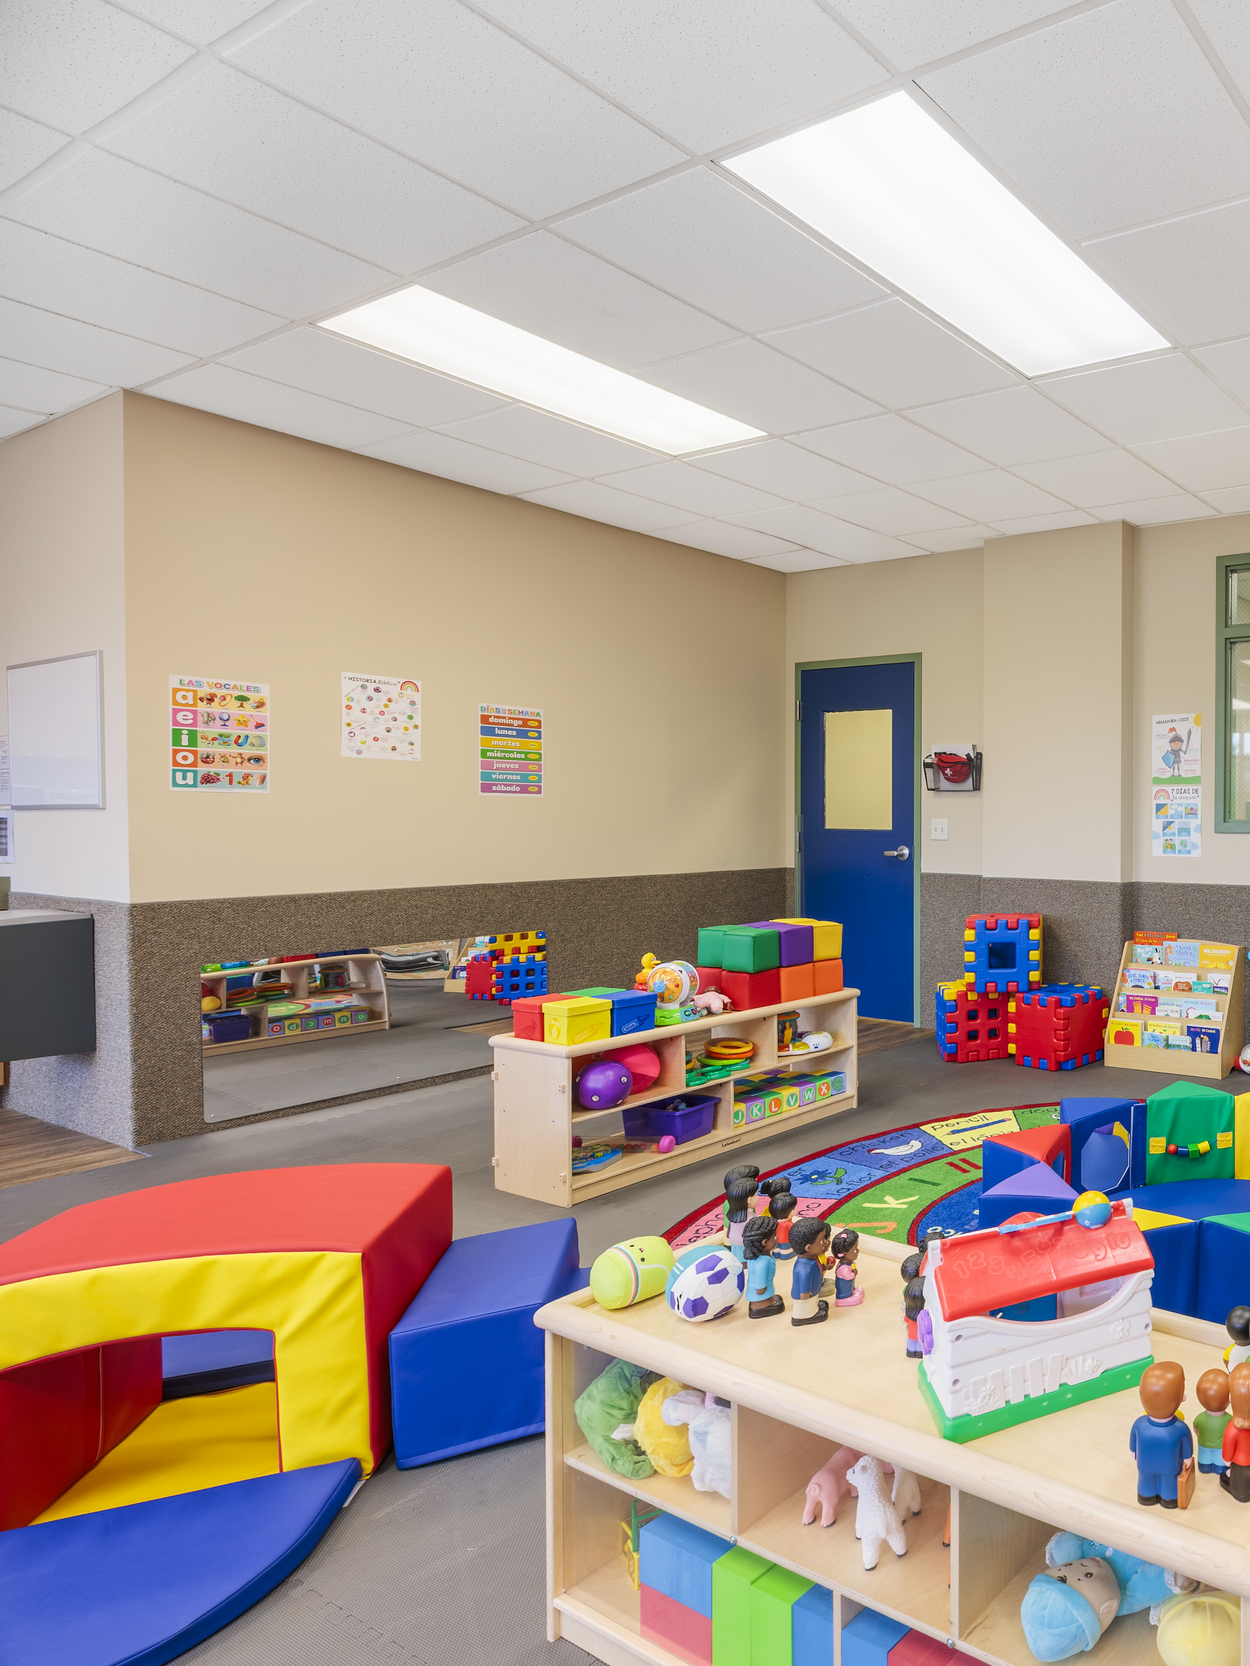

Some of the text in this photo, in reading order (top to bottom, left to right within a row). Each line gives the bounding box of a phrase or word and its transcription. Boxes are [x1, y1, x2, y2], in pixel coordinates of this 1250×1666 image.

[179, 679, 261, 693] LAS VOCALES
[176, 691, 194, 705] a
[176, 711, 194, 724] e
[480, 705, 501, 714] DÍAS
[507, 709, 541, 718] SEMANA
[489, 716, 522, 727] domingo
[181, 730, 189, 746] i
[495, 728, 517, 736] lunes
[176, 751, 194, 765] o
[493, 761, 519, 769] jueves
[175, 771, 194, 785] u
[805, 1090, 814, 1100] W
[821, 1084, 828, 1094] X
[772, 1101, 779, 1111] L
[789, 1096, 796, 1106] V
[734, 1111, 741, 1123] J
[753, 1105, 760, 1116] K
[932, 1115, 989, 1131] pencil
[839, 1132, 913, 1156] chicken
[880, 1146, 944, 1169] el pollo
[846, 1173, 876, 1186] flor
[954, 1261, 970, 1278] 1
[967, 1251, 985, 1269] 2
[988, 1256, 1006, 1274] 3
[1021, 1250, 1040, 1270] 5
[1092, 1243, 1107, 1261] 9
[1105, 1231, 1131, 1249] 10
